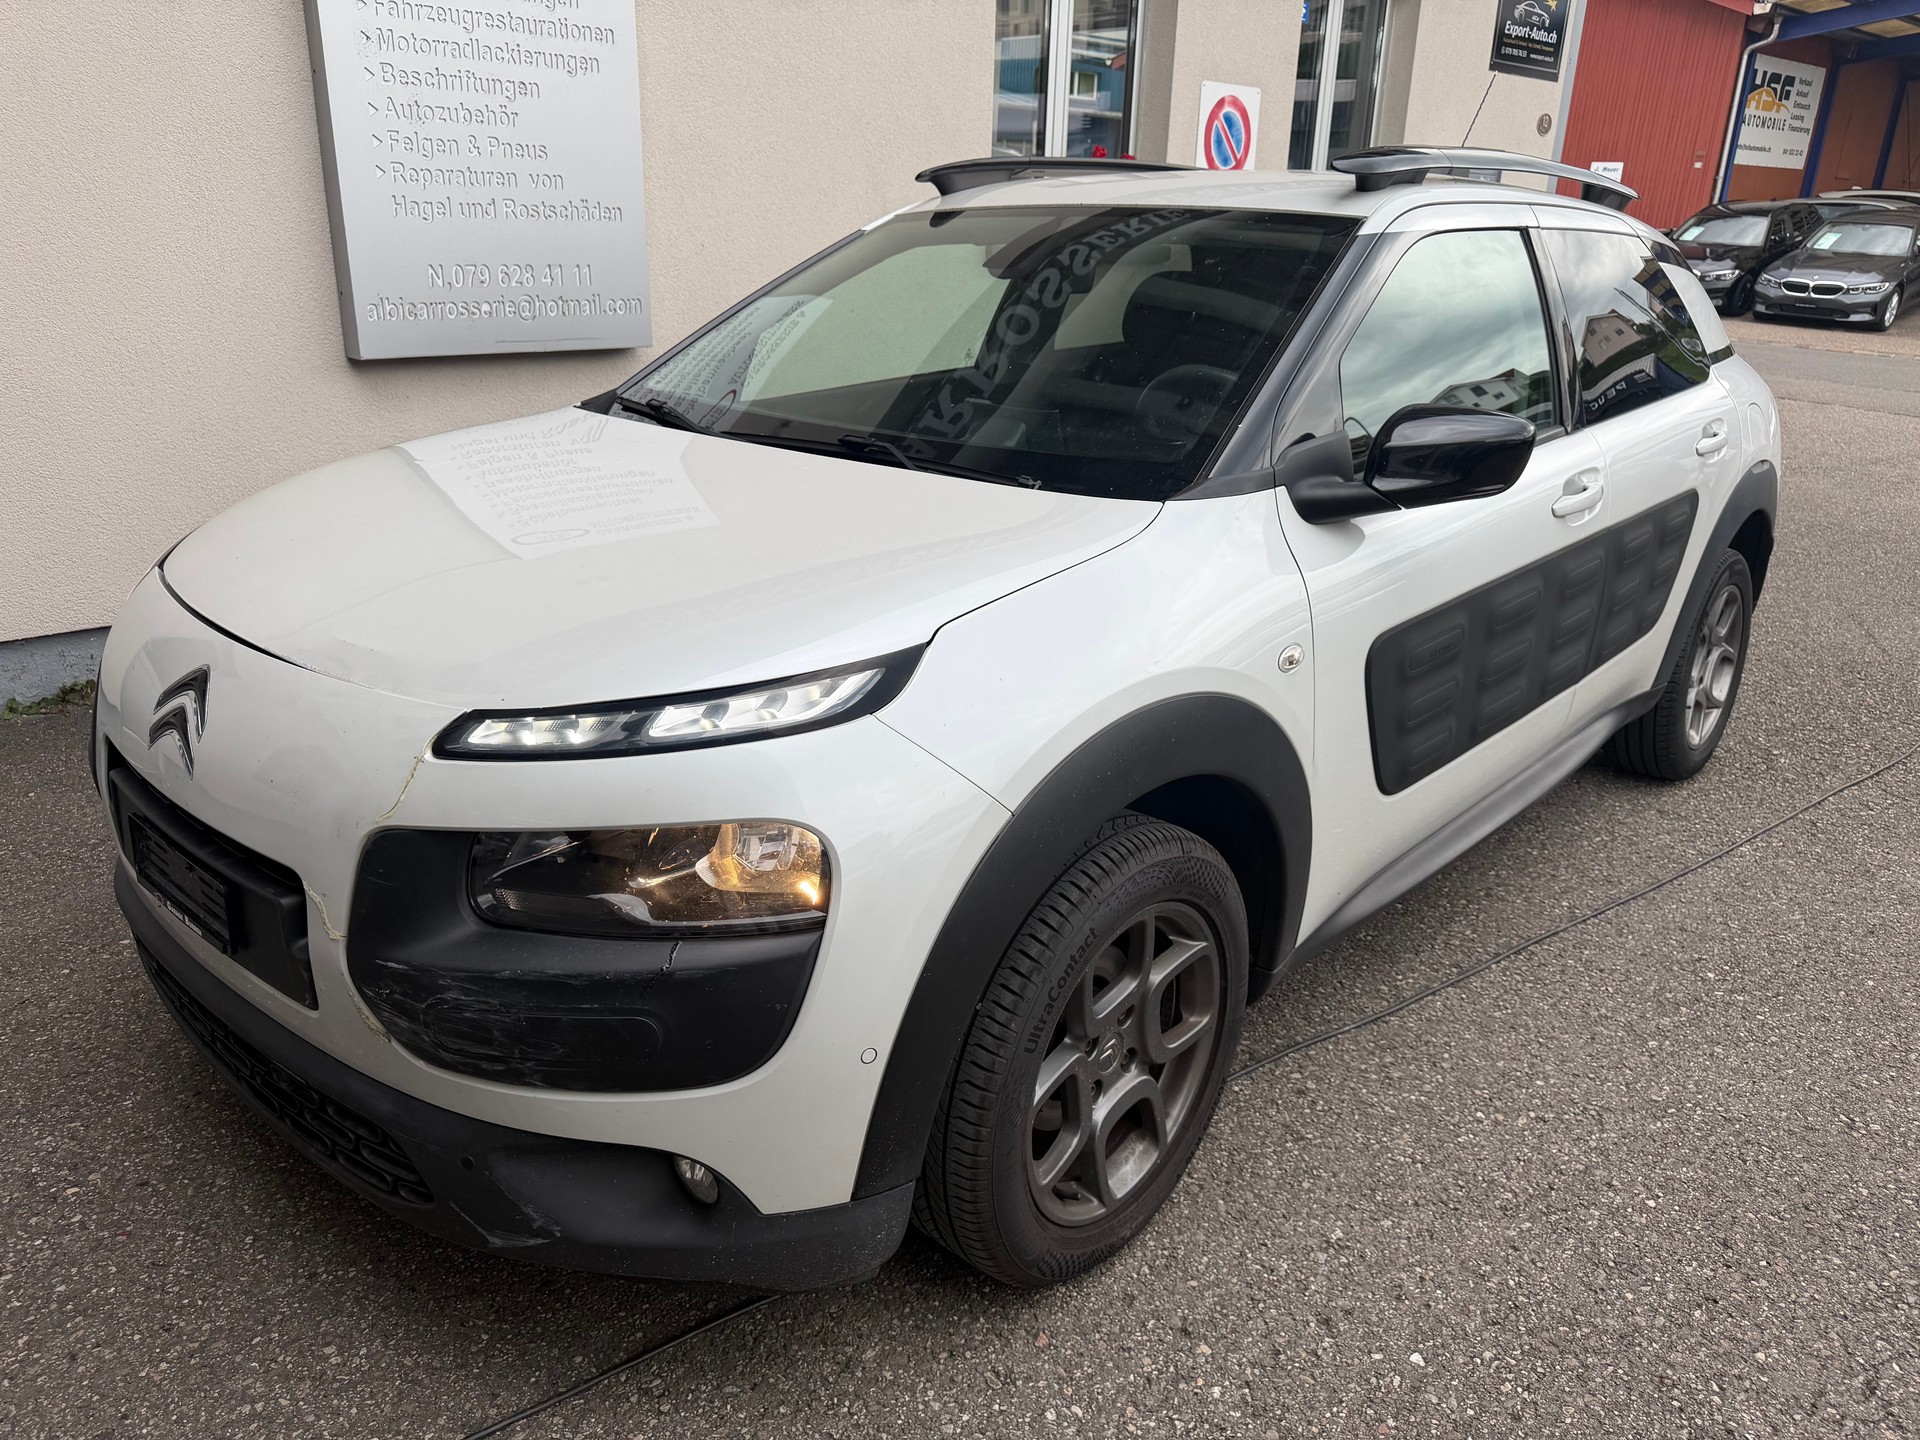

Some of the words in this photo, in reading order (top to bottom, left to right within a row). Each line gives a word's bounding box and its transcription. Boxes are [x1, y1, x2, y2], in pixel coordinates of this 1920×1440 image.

[1504, 20, 1557, 44] Export-Auto.ch
[376, 27, 601, 77] Motorradlackierungen
[380, 62, 541, 102] Beschriftungen
[385, 97, 519, 128] Autozubehör
[387, 129, 460, 160] Felgen
[467, 134, 482, 158] &
[488, 136, 549, 161] Pneus
[391, 162, 518, 190] Reparaturen
[529, 172, 564, 191] von
[392, 195, 452, 224] Hagel
[458, 198, 497, 219] und
[503, 198, 623, 223] Rostschäden
[498, 264, 536, 287] 628
[541, 264, 564, 286] 41
[572, 263, 593, 286] 11
[367, 293, 643, 323] albicarrosserie@hotmail.com
[1023, 926, 1099, 1054] UltraContact
